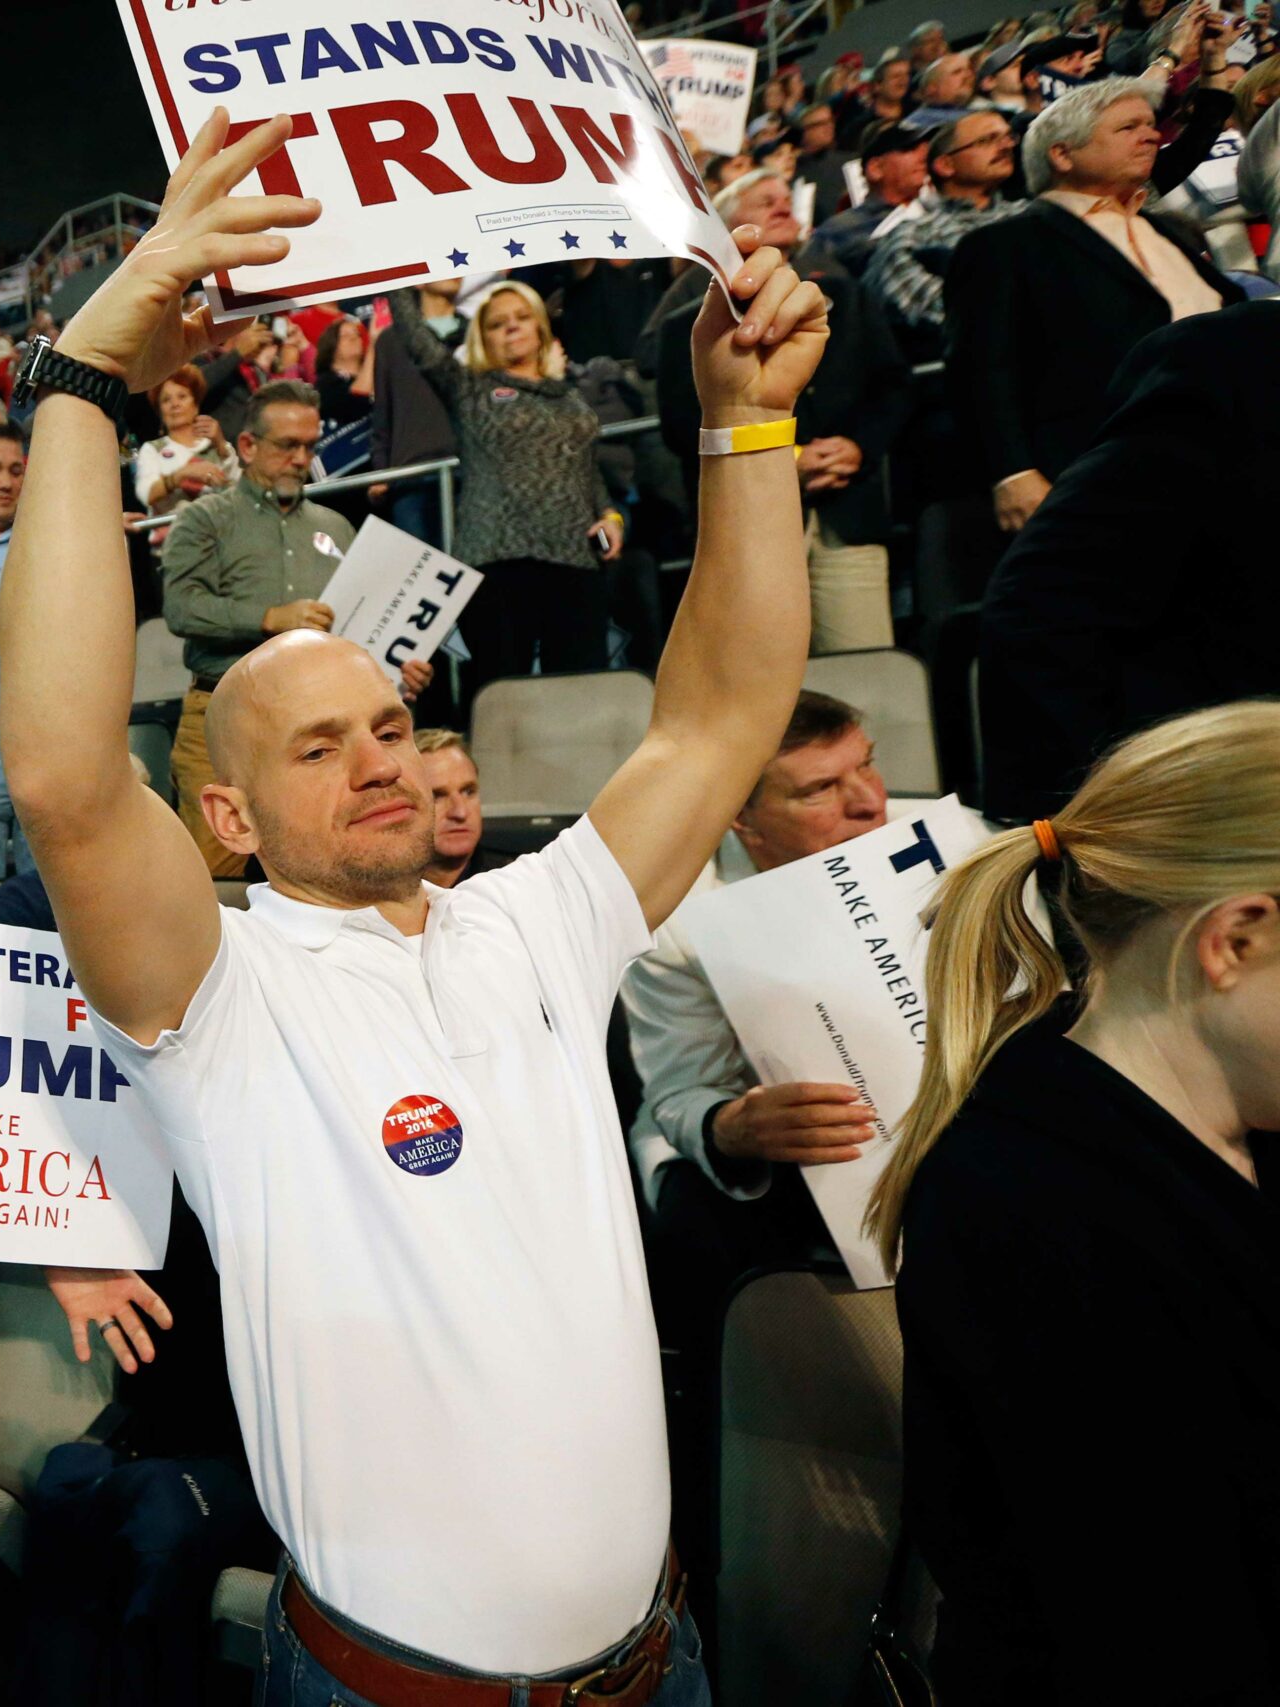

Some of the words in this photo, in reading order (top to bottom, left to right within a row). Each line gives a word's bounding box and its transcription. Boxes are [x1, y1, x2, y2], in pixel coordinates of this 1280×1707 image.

[182, 20, 516, 95] STANDS
[403, 549, 432, 587] MAKE
[367, 587, 407, 645] AMERICA
[385, 569, 465, 669] TRU
[823, 855, 879, 931] MAKE
[863, 936, 926, 1047] AMERIC
[386, 1102, 443, 1127] TRUMP
[405, 1119, 434, 1135] 2016
[399, 1137, 460, 1164] AMERICA
[415, 1135, 434, 1147] MAKE
[408, 1158, 431, 1170] GREAT
[431, 1151, 455, 1164] AGAIN!
